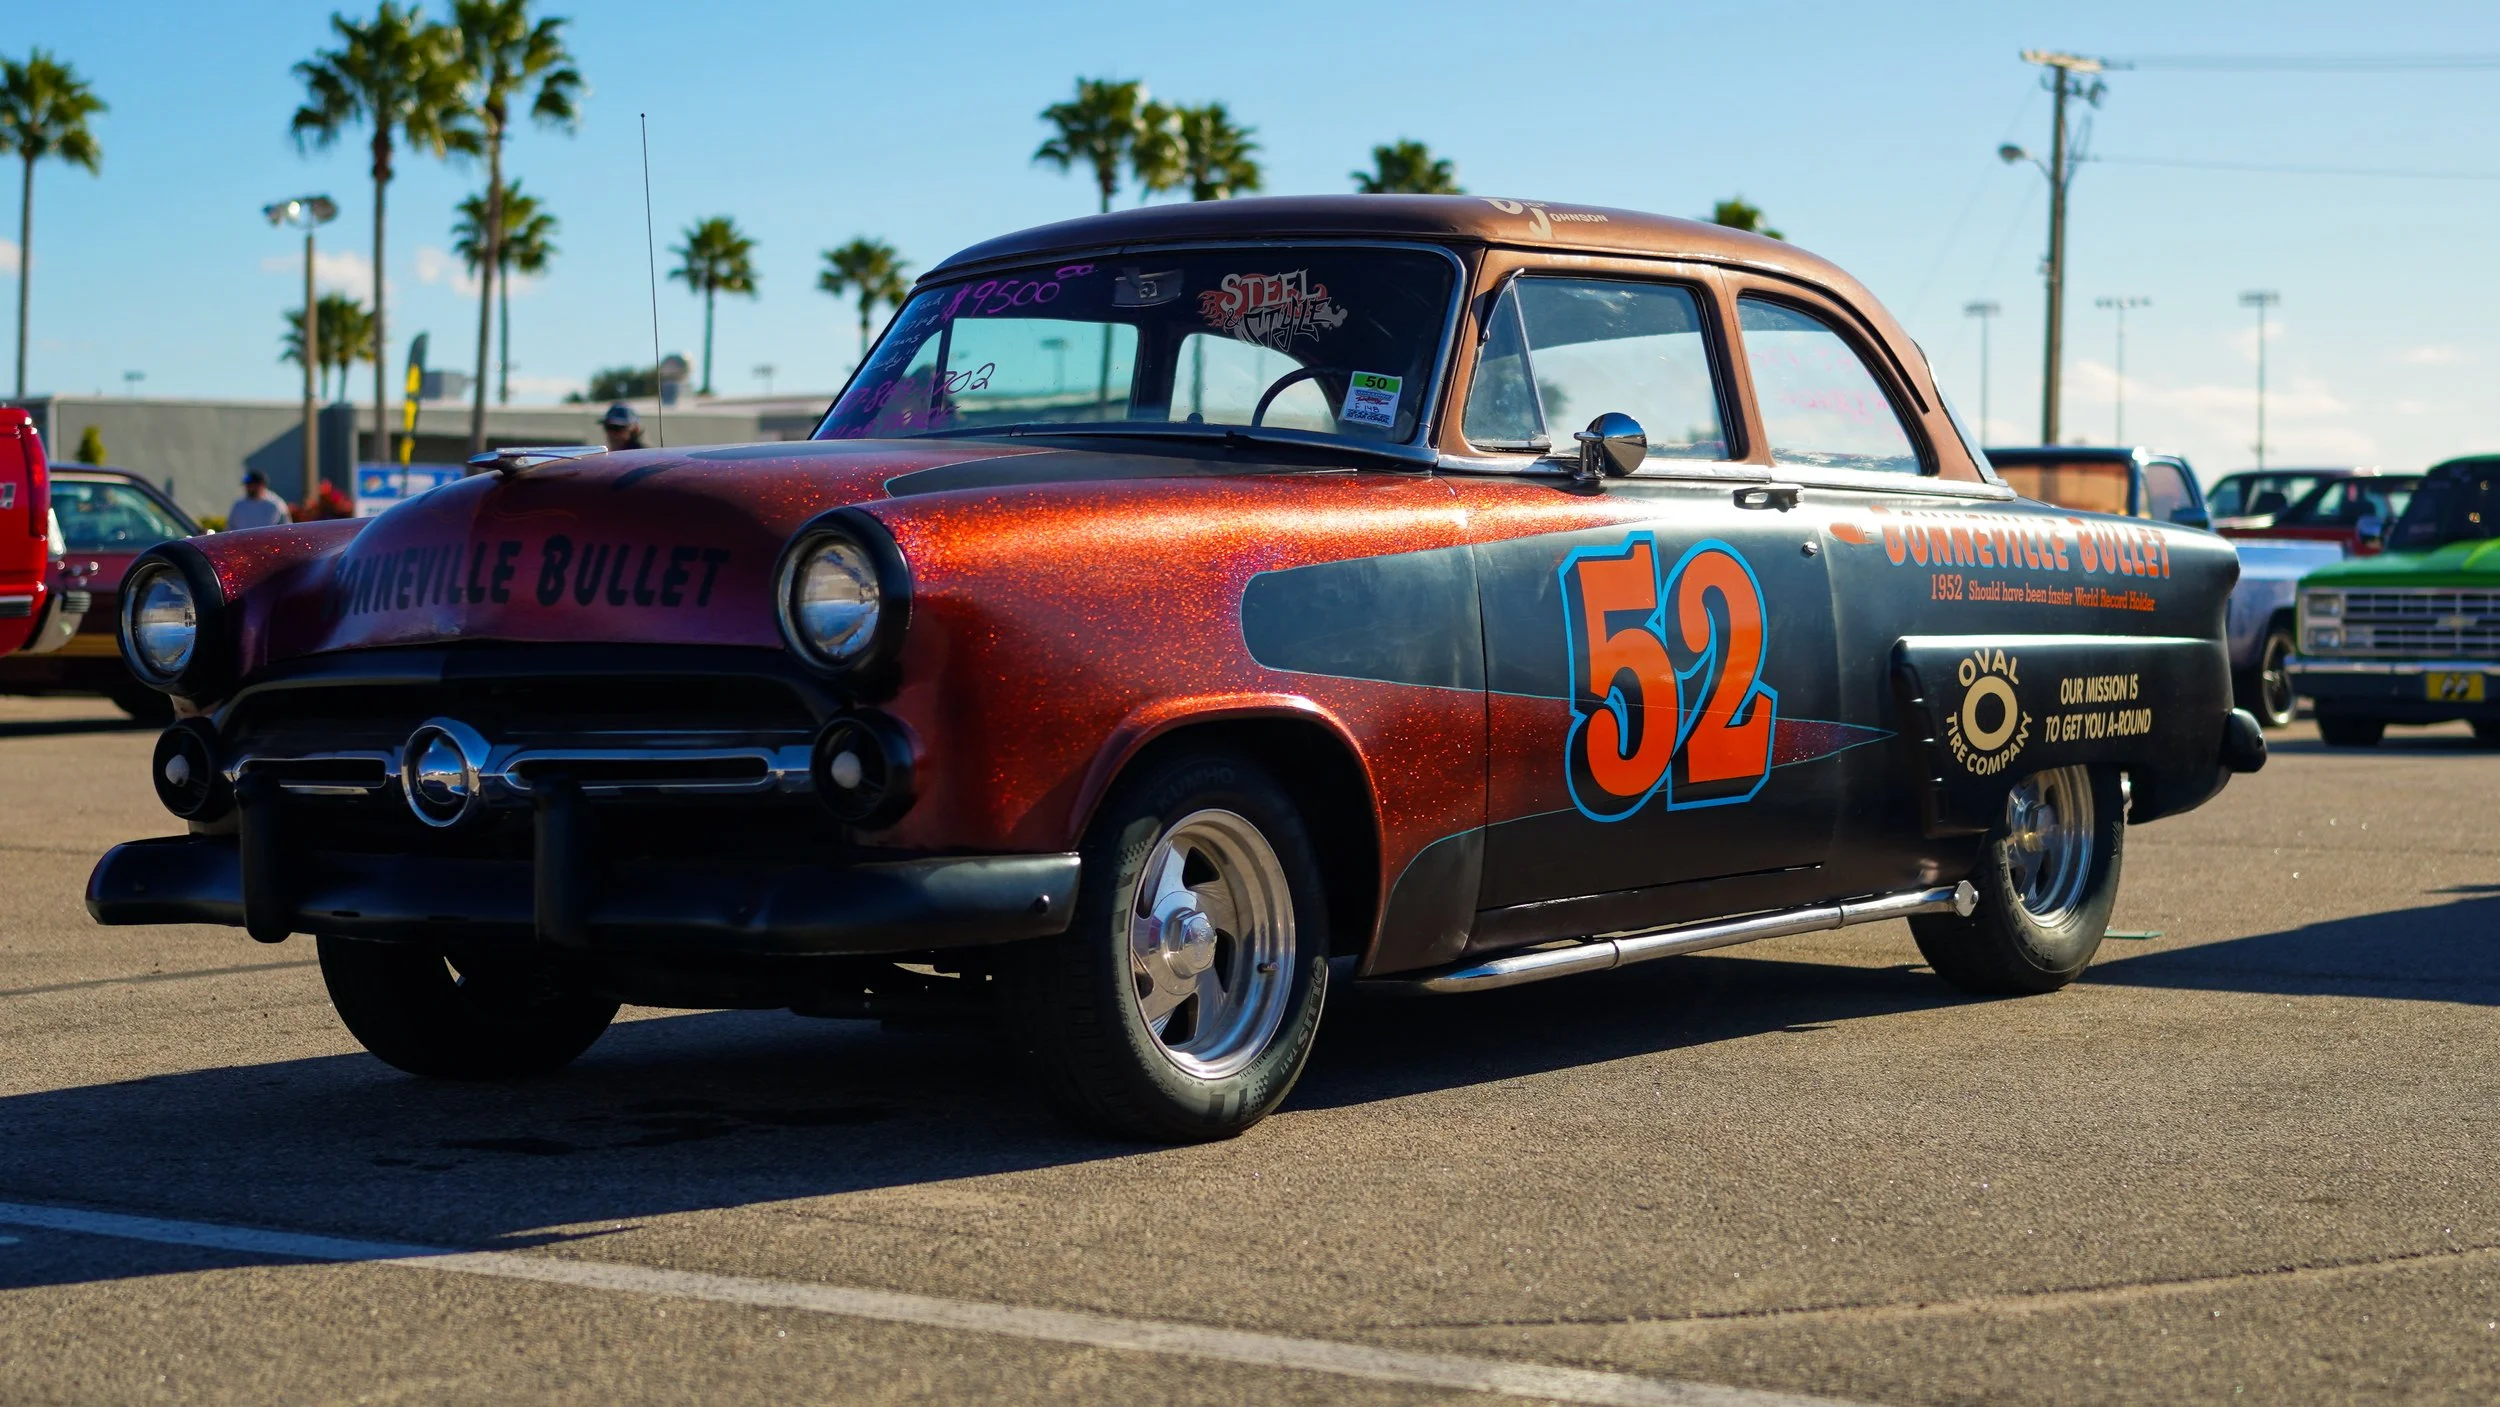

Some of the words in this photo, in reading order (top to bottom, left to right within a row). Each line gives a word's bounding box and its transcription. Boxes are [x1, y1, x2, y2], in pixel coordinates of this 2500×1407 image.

[1528, 207, 1609, 241] JOHNSON
[1220, 268, 1321, 317] STEEL
[1365, 376, 1387, 389] 50
[2066, 517, 2170, 578] BULLET
[535, 535, 732, 608] BULLET
[1930, 574, 1963, 600] 1952
[1968, 580, 2001, 601] Should
[2002, 584, 2025, 602] have
[2026, 586, 2046, 604] been
[2048, 587, 2073, 606] faster
[2074, 587, 2099, 607] World
[2100, 589, 2127, 609] Record
[1561, 533, 1777, 820] 52
[1958, 647, 2019, 687] OVAL
[2060, 677, 2083, 705] OUR
[2085, 674, 2127, 702] MISSION
[2129, 673, 2139, 700] IS
[1945, 711, 1965, 764] TIRE
[1967, 711, 2033, 776] COMPANY
[2045, 715, 2060, 743] TO
[2060, 713, 2082, 742] GET
[2084, 711, 2106, 740] YOU
[2107, 708, 2151, 736] A-ROUND
